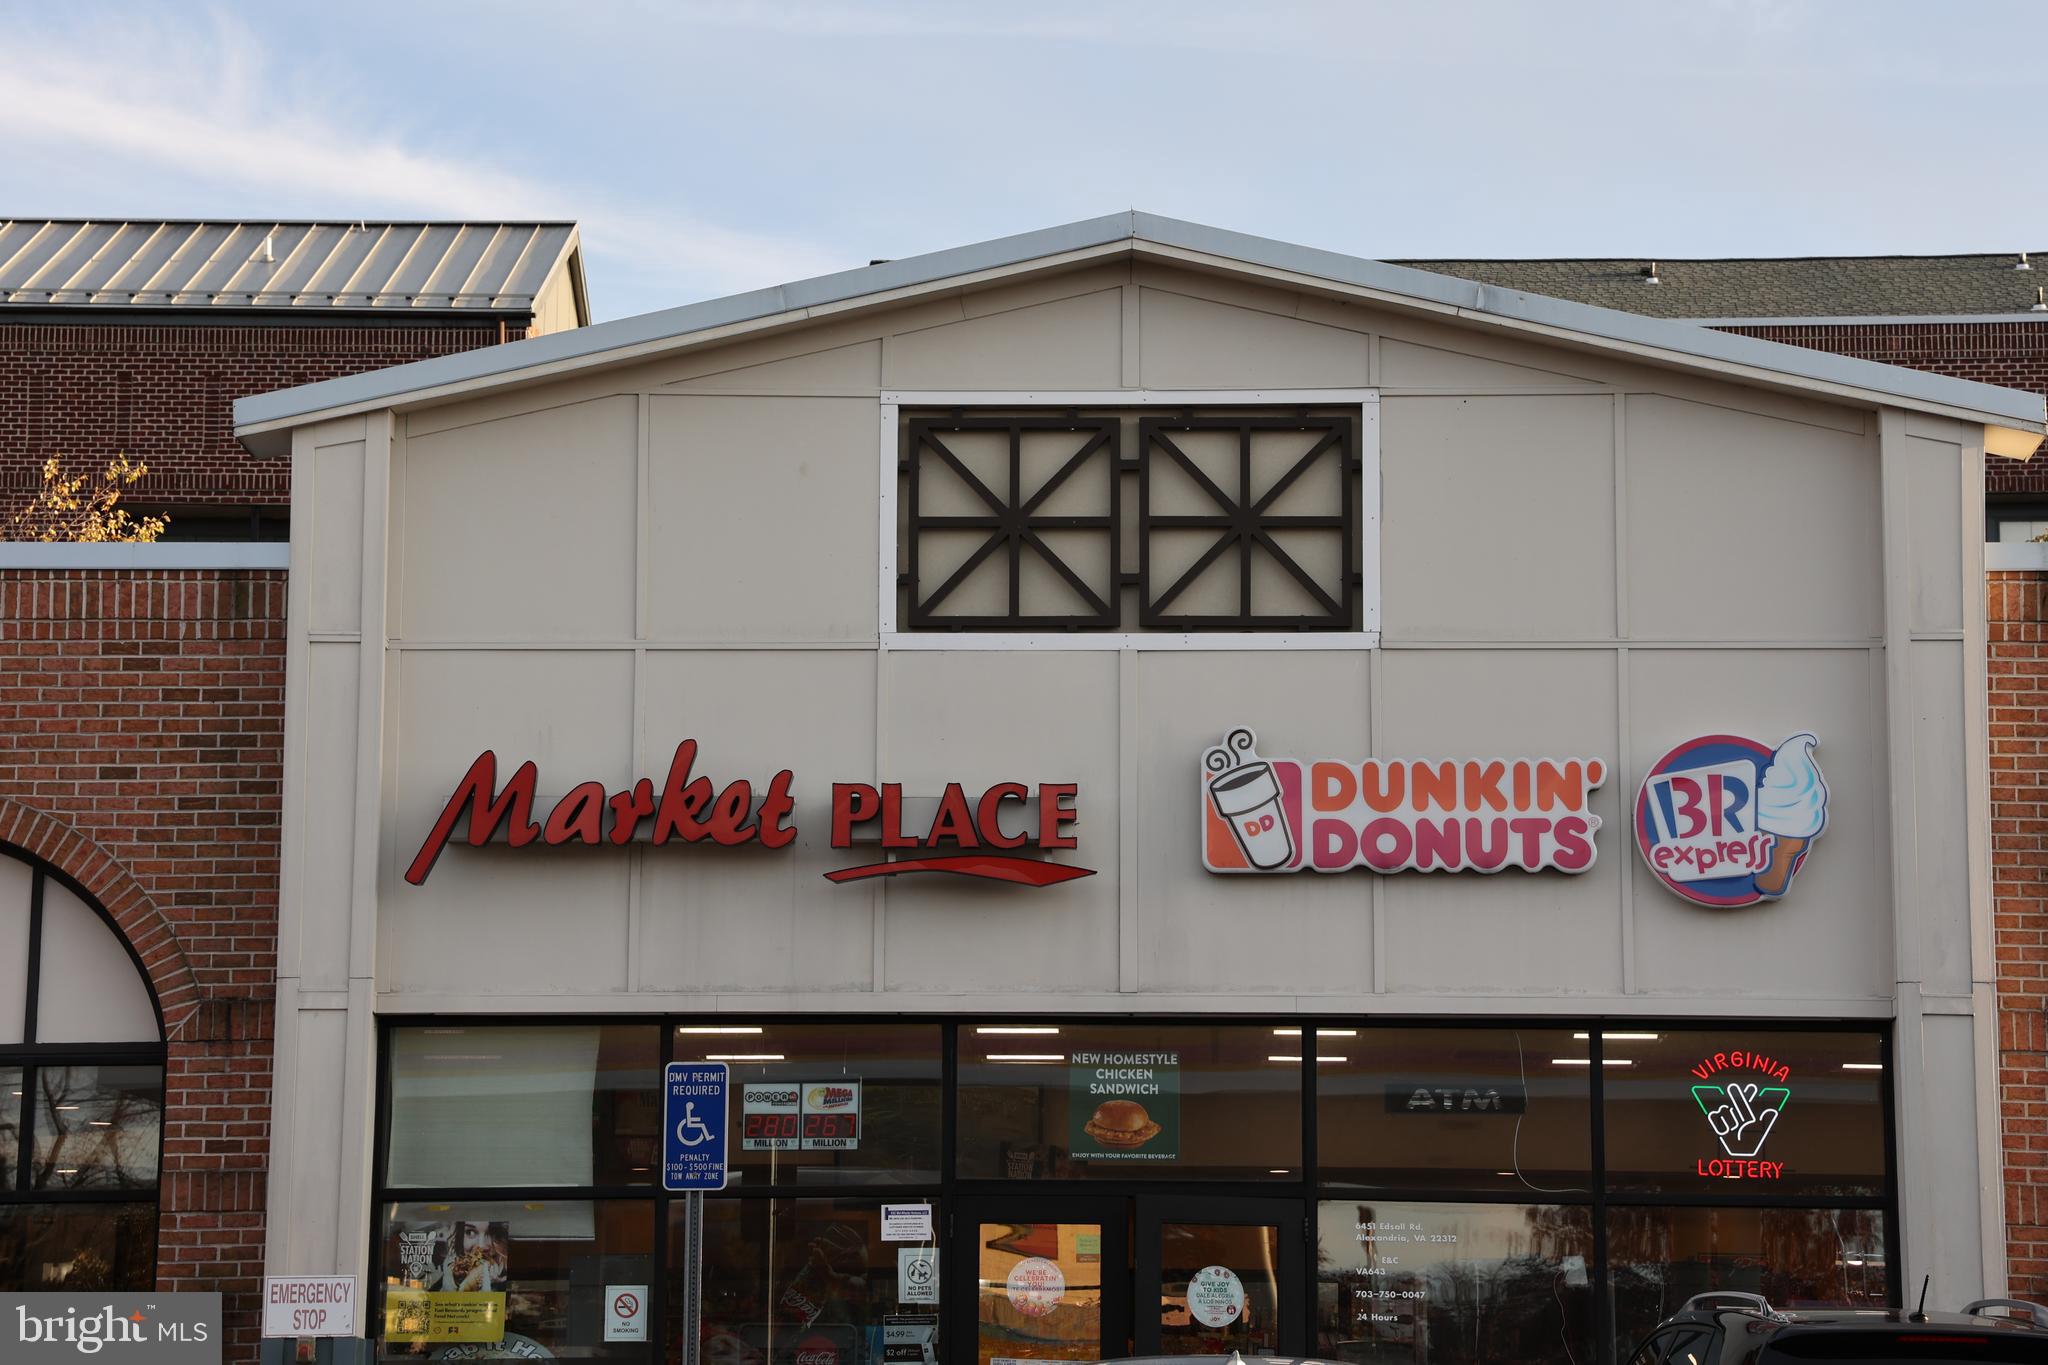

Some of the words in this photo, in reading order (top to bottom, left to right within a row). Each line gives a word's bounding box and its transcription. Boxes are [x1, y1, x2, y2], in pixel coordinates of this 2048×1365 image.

[1311, 761, 1602, 812] DUNKIN'
[404, 739, 797, 886] Market
[831, 782, 1079, 849] PLACE
[1653, 774, 1749, 839] BR
[1244, 815, 1275, 837] DD
[1311, 817, 1595, 868] DONUTS
[1654, 835, 1771, 874] express
[1072, 1053, 1100, 1064] NEW
[1104, 1054, 1178, 1065] HOMESTYLE
[1691, 1051, 1790, 1082] VIRGINIA
[669, 1072, 688, 1083] DMV
[692, 1072, 725, 1083] PERMIT
[1096, 1068, 1153, 1080] CHICKEN
[673, 1085, 720, 1096] REQUIRED
[825, 1087, 853, 1098] MEGA
[1090, 1083, 1159, 1095] SANDWICH
[1408, 1089, 1500, 1110] ATM
[747, 1115, 797, 1137] 280
[806, 1115, 856, 1137] 267
[754, 1139, 788, 1147] MILLON
[812, 1139, 847, 1147] MILLION
[1698, 1159, 1783, 1179] LOTTERY
[671, 1172, 682, 1180] TOW
[686, 1172, 700, 1180] AWAY
[704, 1172, 719, 1180] ZONE
[1410, 1223, 1424, 1231] Rd.
[1356, 1234, 1409, 1243] Alexandria,
[400, 1245, 434, 1255] STATION
[401, 1254, 432, 1264] NATION
[271, 1282, 351, 1304] EMERGENCY
[1356, 1290, 1426, 1299] 703-750-0047
[293, 1309, 327, 1330] STOP
[1371, 1313, 1398, 1321] Hours
